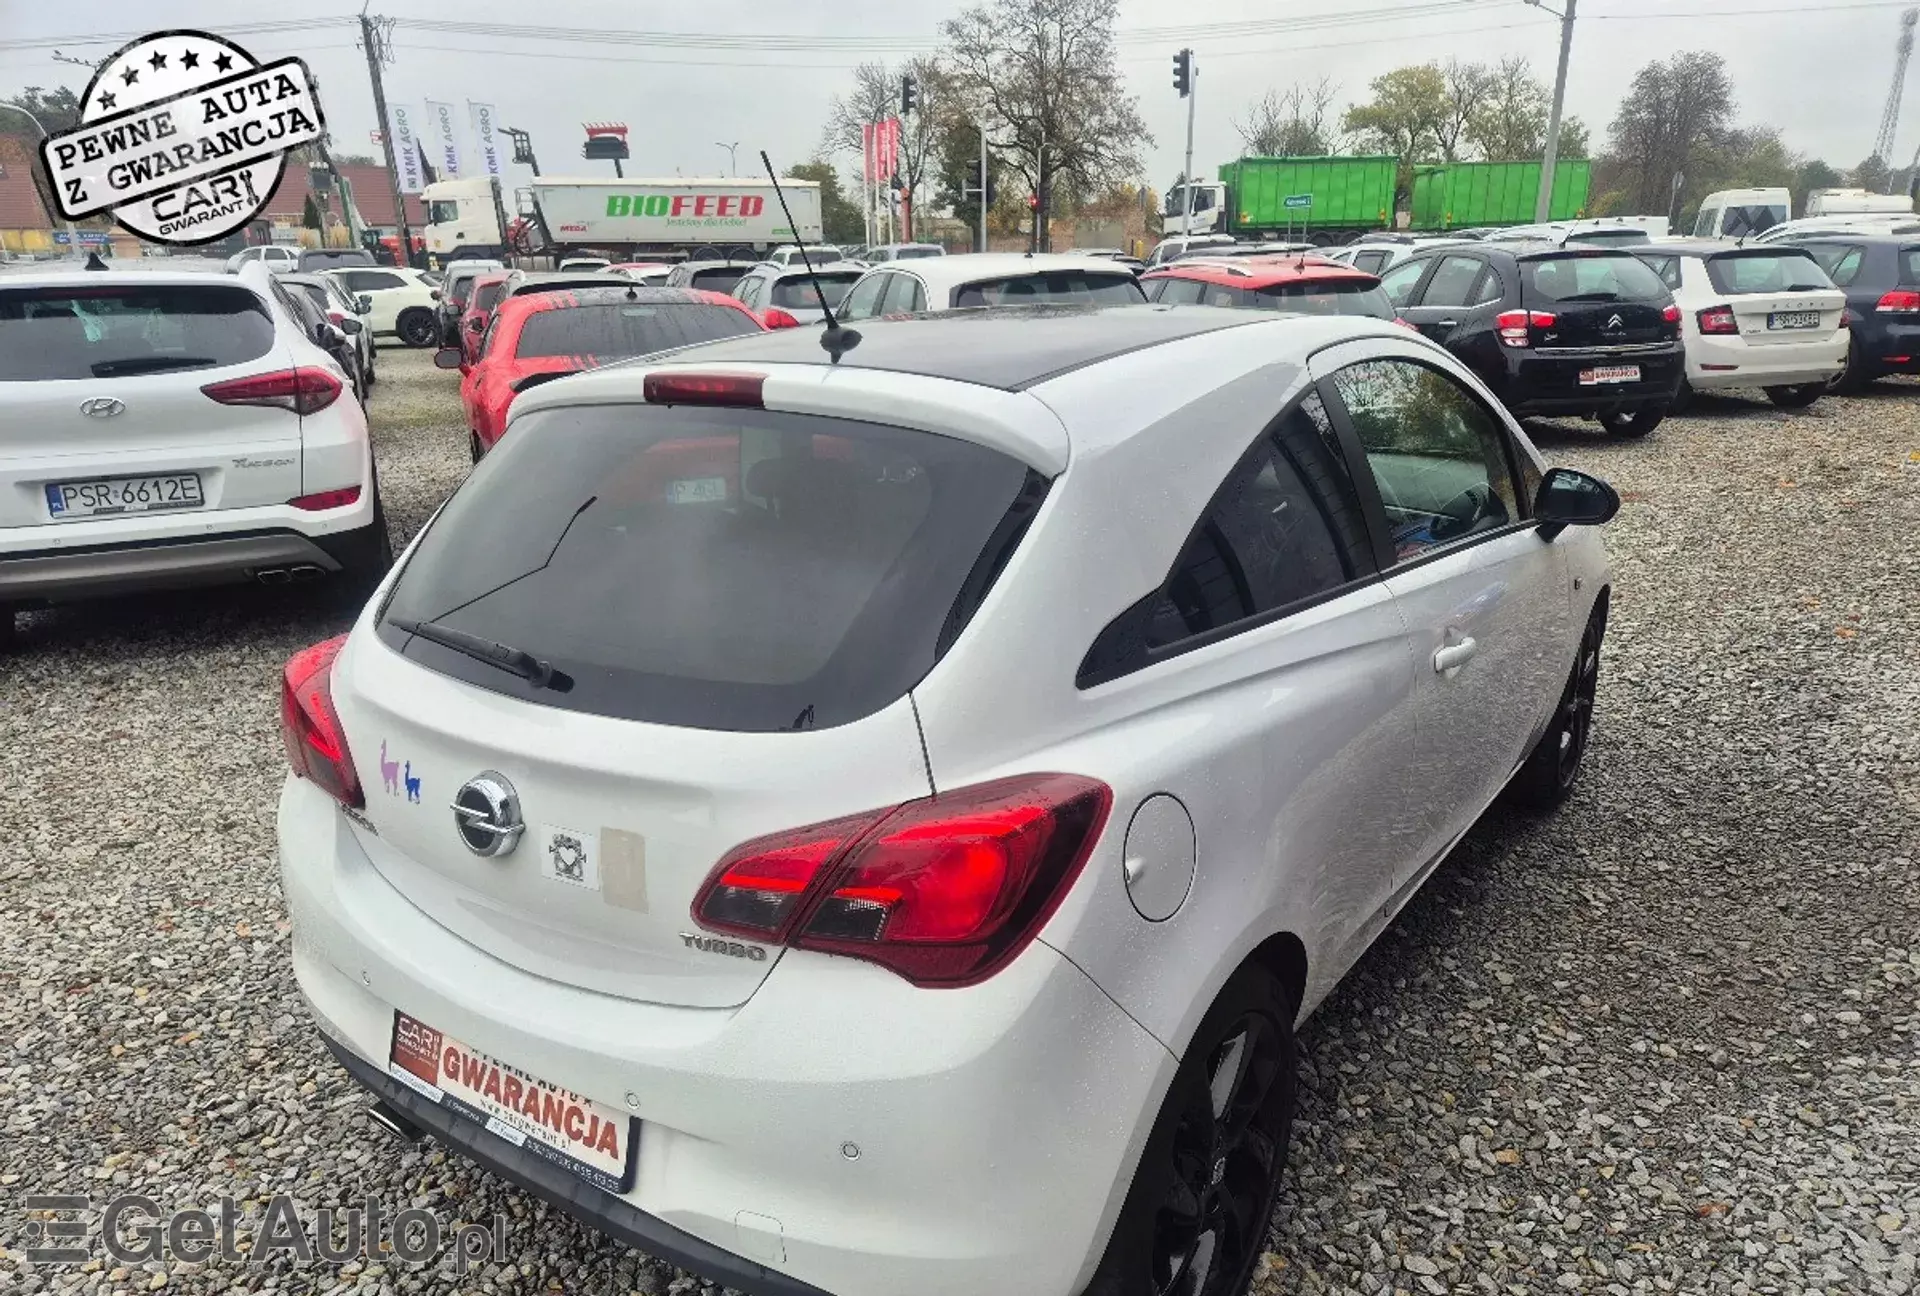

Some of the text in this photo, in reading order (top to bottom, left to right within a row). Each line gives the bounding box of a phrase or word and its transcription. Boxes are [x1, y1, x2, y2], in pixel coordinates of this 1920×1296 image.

[395, 108, 417, 176] KMK AGRO
[438, 106, 457, 174] KMK AGRO
[479, 107, 499, 174] KMK AGRO
[606, 195, 764, 217] BIOFEED
[62, 484, 112, 510] PSR
[121, 477, 198, 504] 6612E
[679, 932, 767, 961] TURBO
[442, 1046, 619, 1160] GWARANCJA
